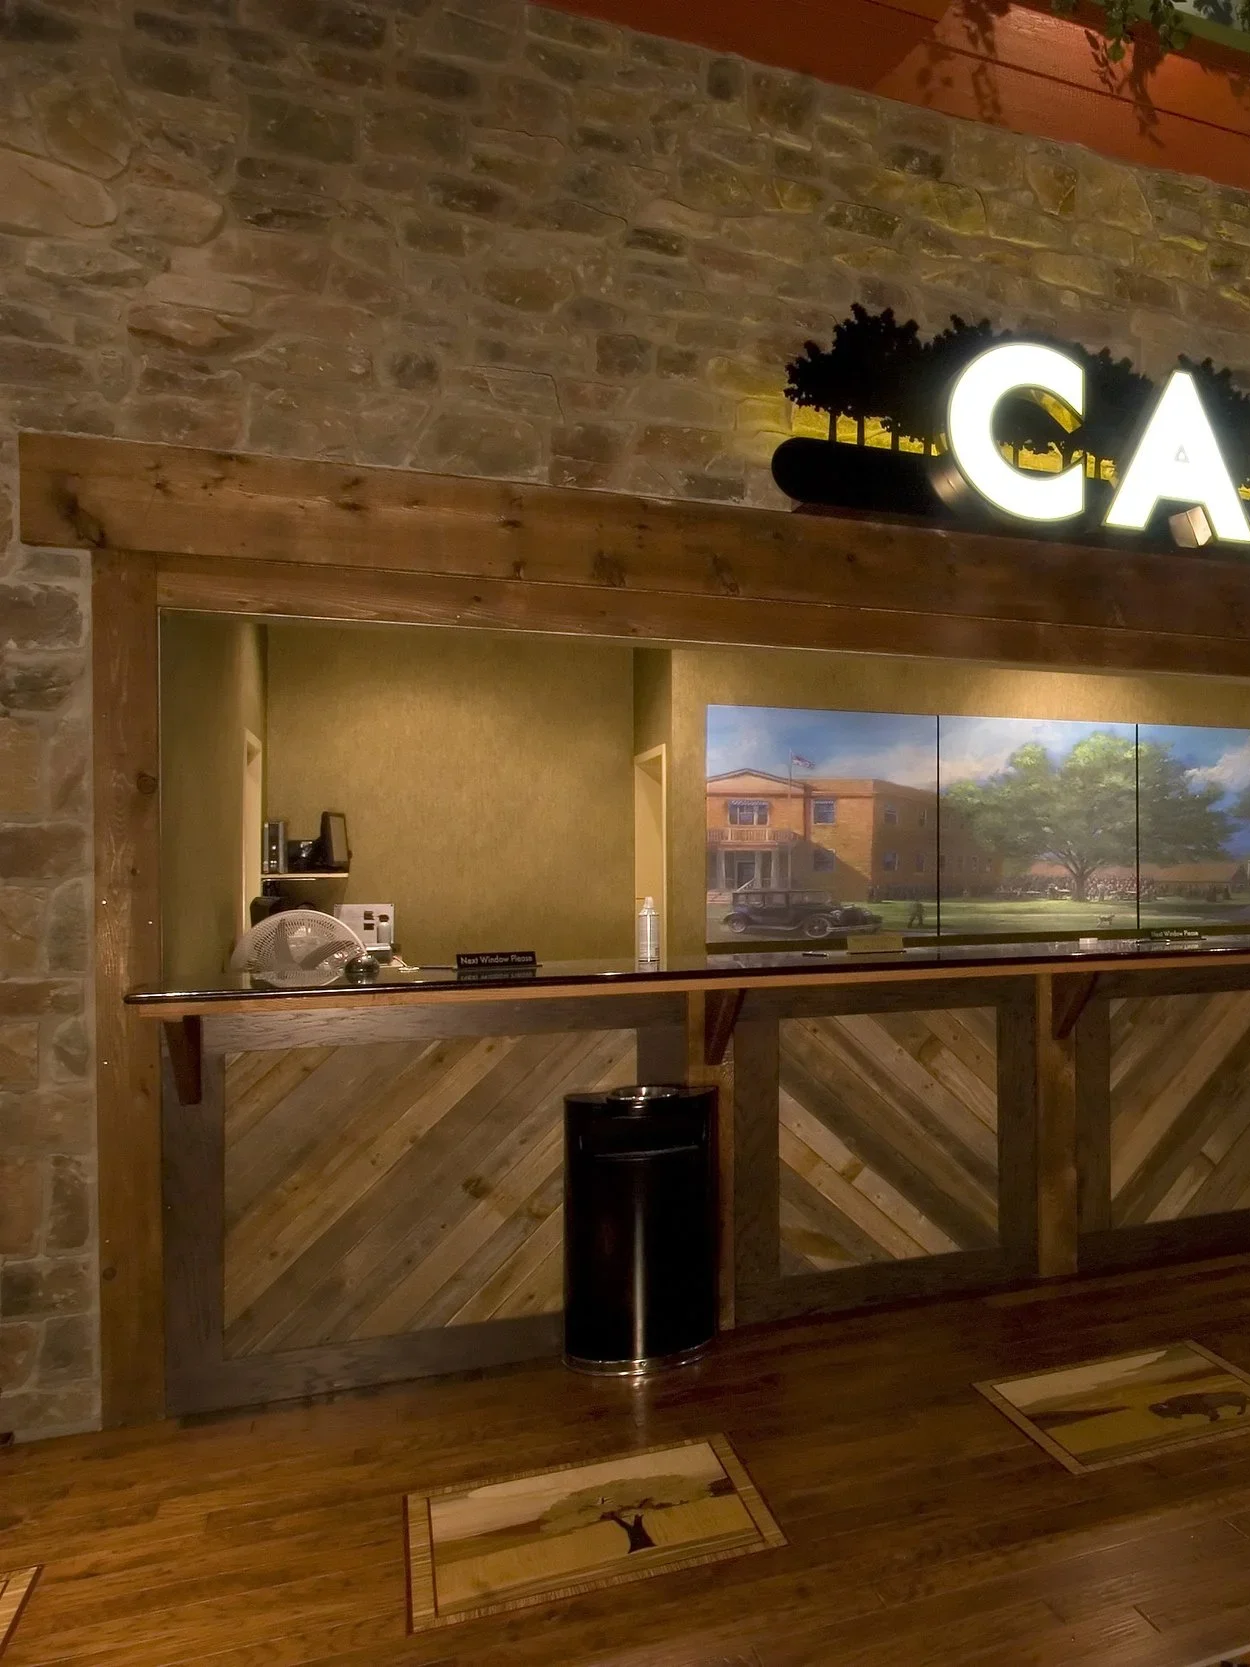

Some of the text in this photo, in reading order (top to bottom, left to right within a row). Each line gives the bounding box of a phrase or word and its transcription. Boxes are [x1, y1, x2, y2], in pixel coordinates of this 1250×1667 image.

[460, 954, 533, 965] Next Window Please
